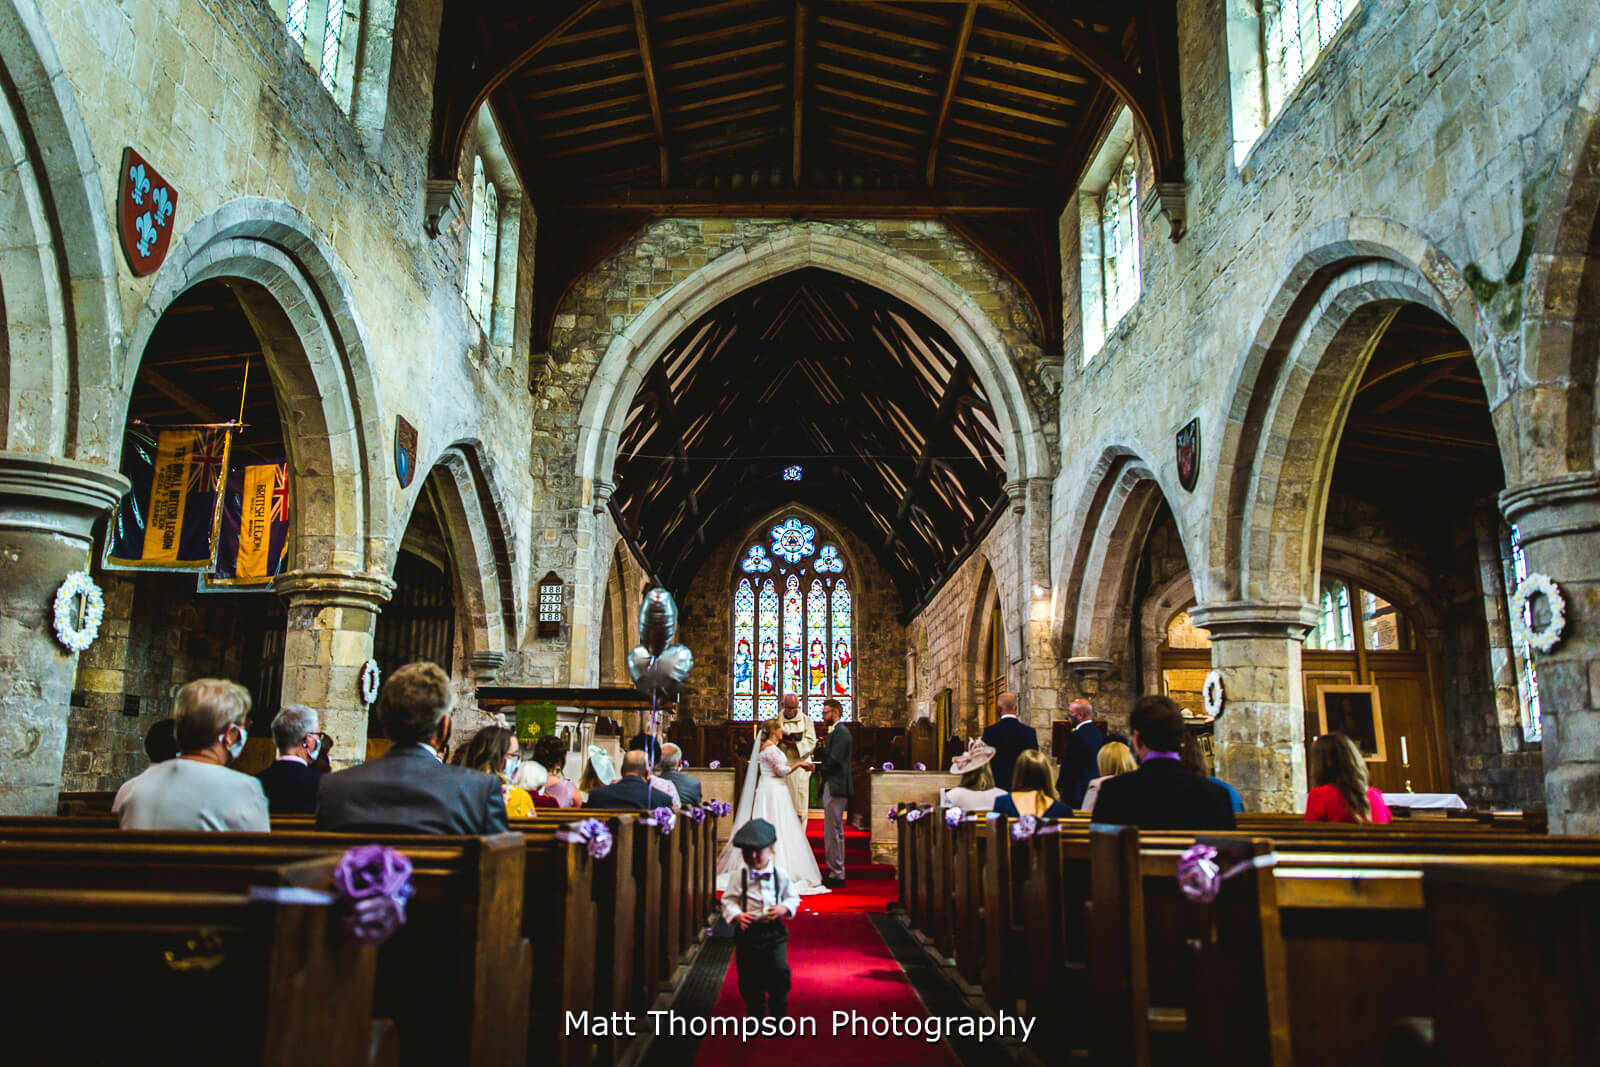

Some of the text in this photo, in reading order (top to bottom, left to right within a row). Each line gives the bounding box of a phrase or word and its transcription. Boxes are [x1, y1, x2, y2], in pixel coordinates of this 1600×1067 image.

[168, 490, 181, 520] BRITISH
[253, 484, 267, 552] BRITISH LEGION
[162, 521, 177, 550] LEGION
[541, 613, 560, 621] 188
